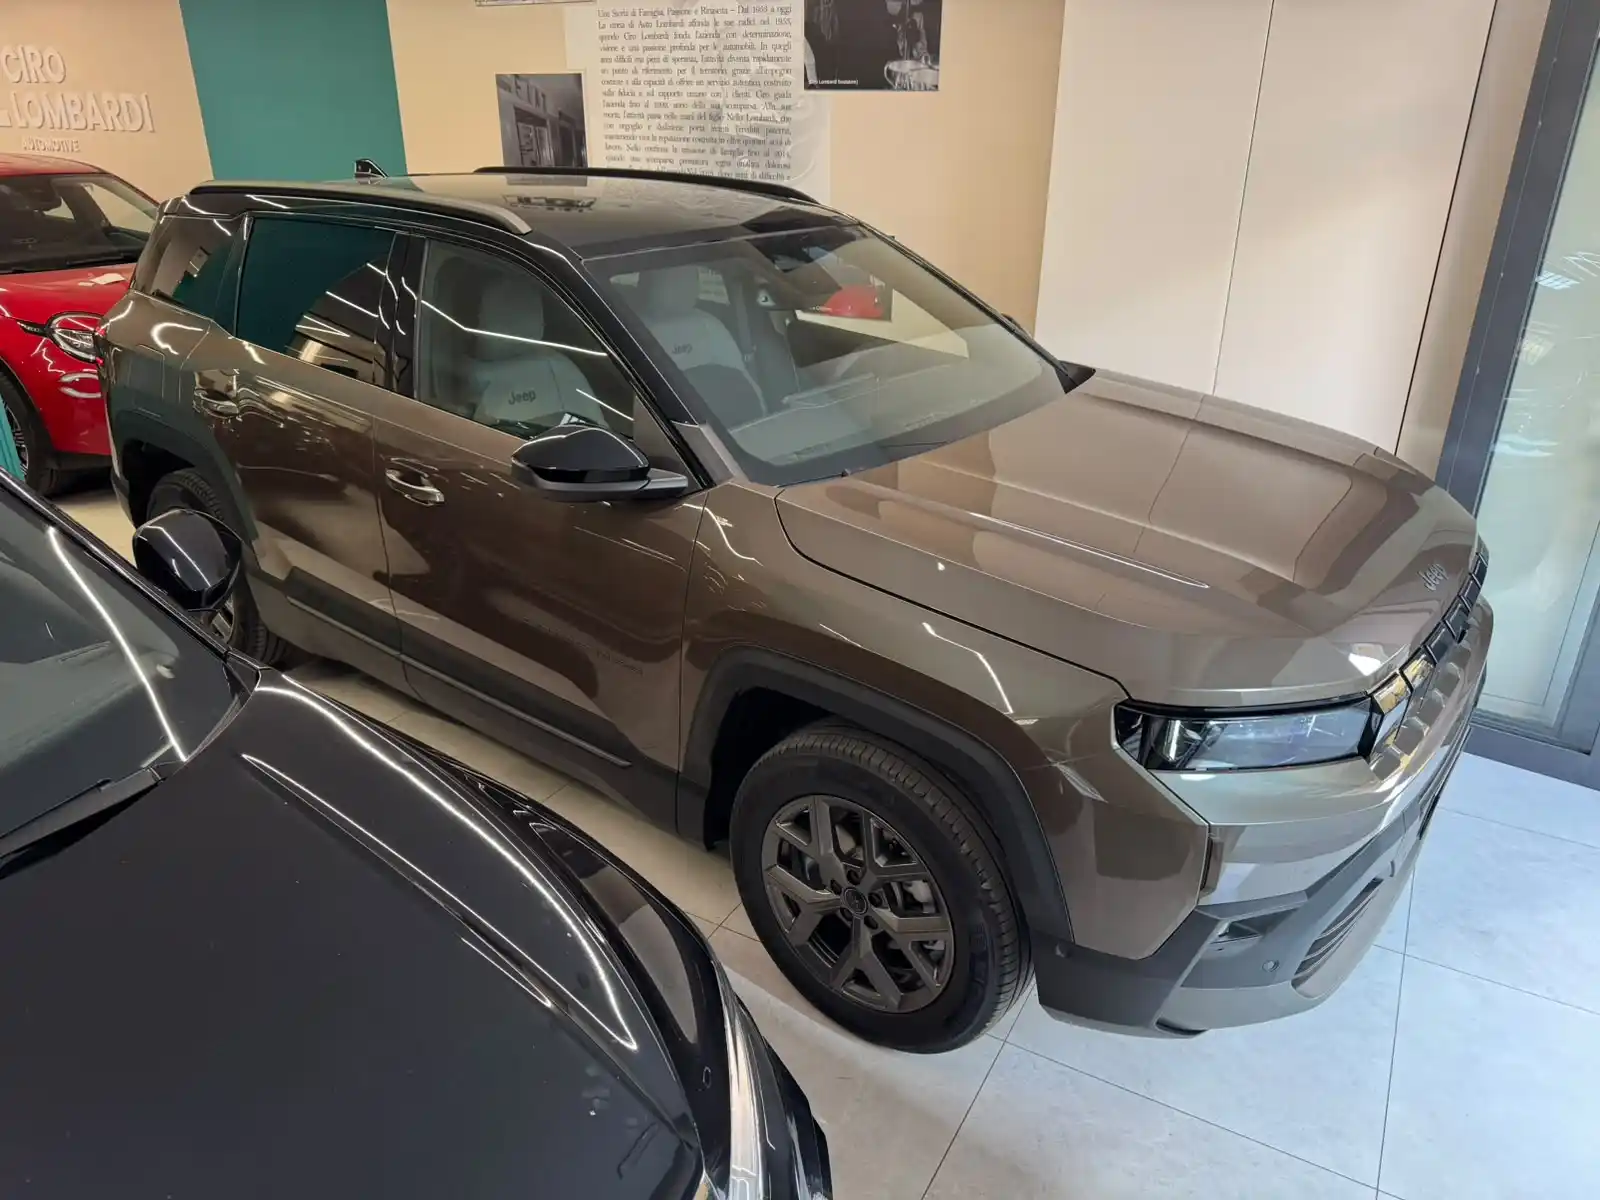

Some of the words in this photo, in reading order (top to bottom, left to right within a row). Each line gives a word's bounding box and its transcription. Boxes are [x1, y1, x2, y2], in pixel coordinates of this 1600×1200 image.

[738, 18, 755, 26] radici
[624, 32, 636, 40] Ciro
[642, 31, 669, 40] Lombardi
[742, 29, 792, 38] determinazione,
[670, 42, 695, 53] profonda
[699, 44, 710, 52] per
[772, 42, 792, 52] quegli
[2, 45, 66, 84] CIRO
[728, 54, 750, 62] diventa
[752, 54, 792, 64] rapidamente
[612, 68, 628, 76] punto
[677, 68, 687, 76] per
[764, 78, 792, 86] costruito
[756, 90, 770, 98] Ciro
[10, 91, 156, 133] LOMBARDI
[689, 124, 704, 134] porta
[22, 136, 81, 153] AUTOMOTIVE
[672, 343, 693, 355] Jeep
[508, 390, 536, 405] Jeep
[1416, 563, 1449, 592] Jeep
